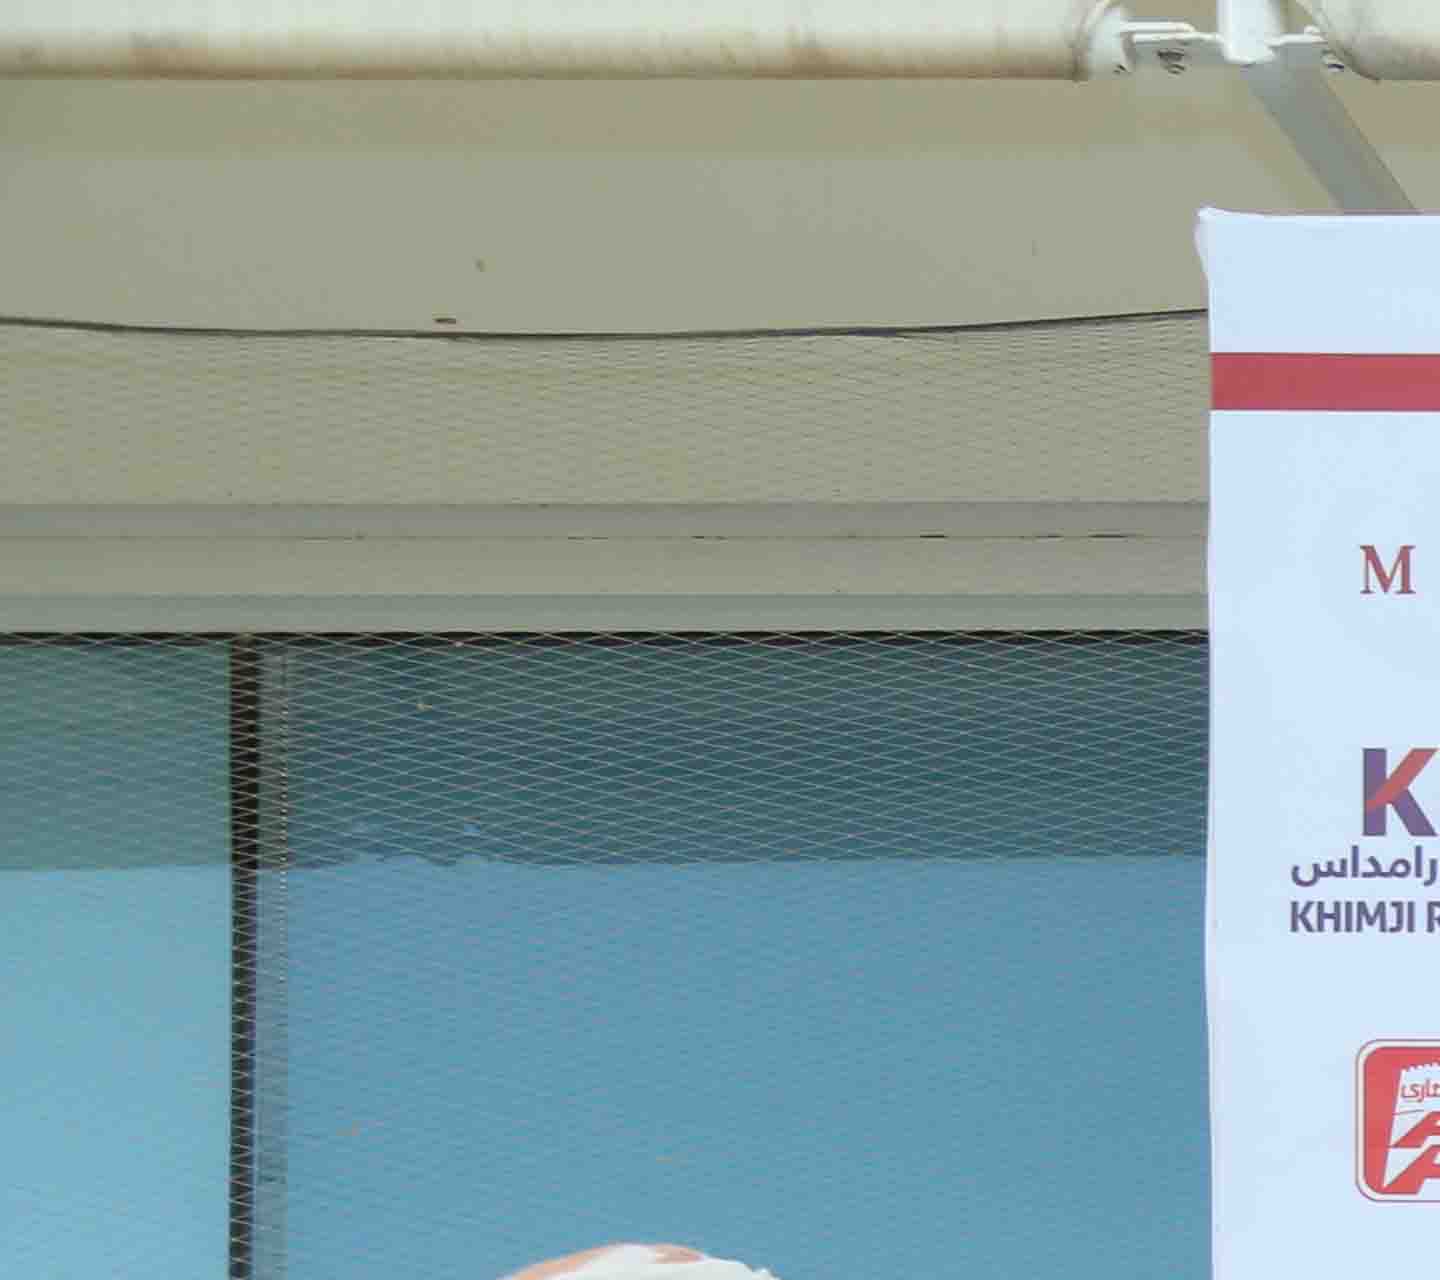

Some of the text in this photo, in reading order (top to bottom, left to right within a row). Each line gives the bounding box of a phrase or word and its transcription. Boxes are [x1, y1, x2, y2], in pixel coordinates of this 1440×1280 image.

[1360, 545, 1416, 595] M
[1291, 845, 1438, 887] رامداس
[1290, 901, 1416, 933] KHIMJI
